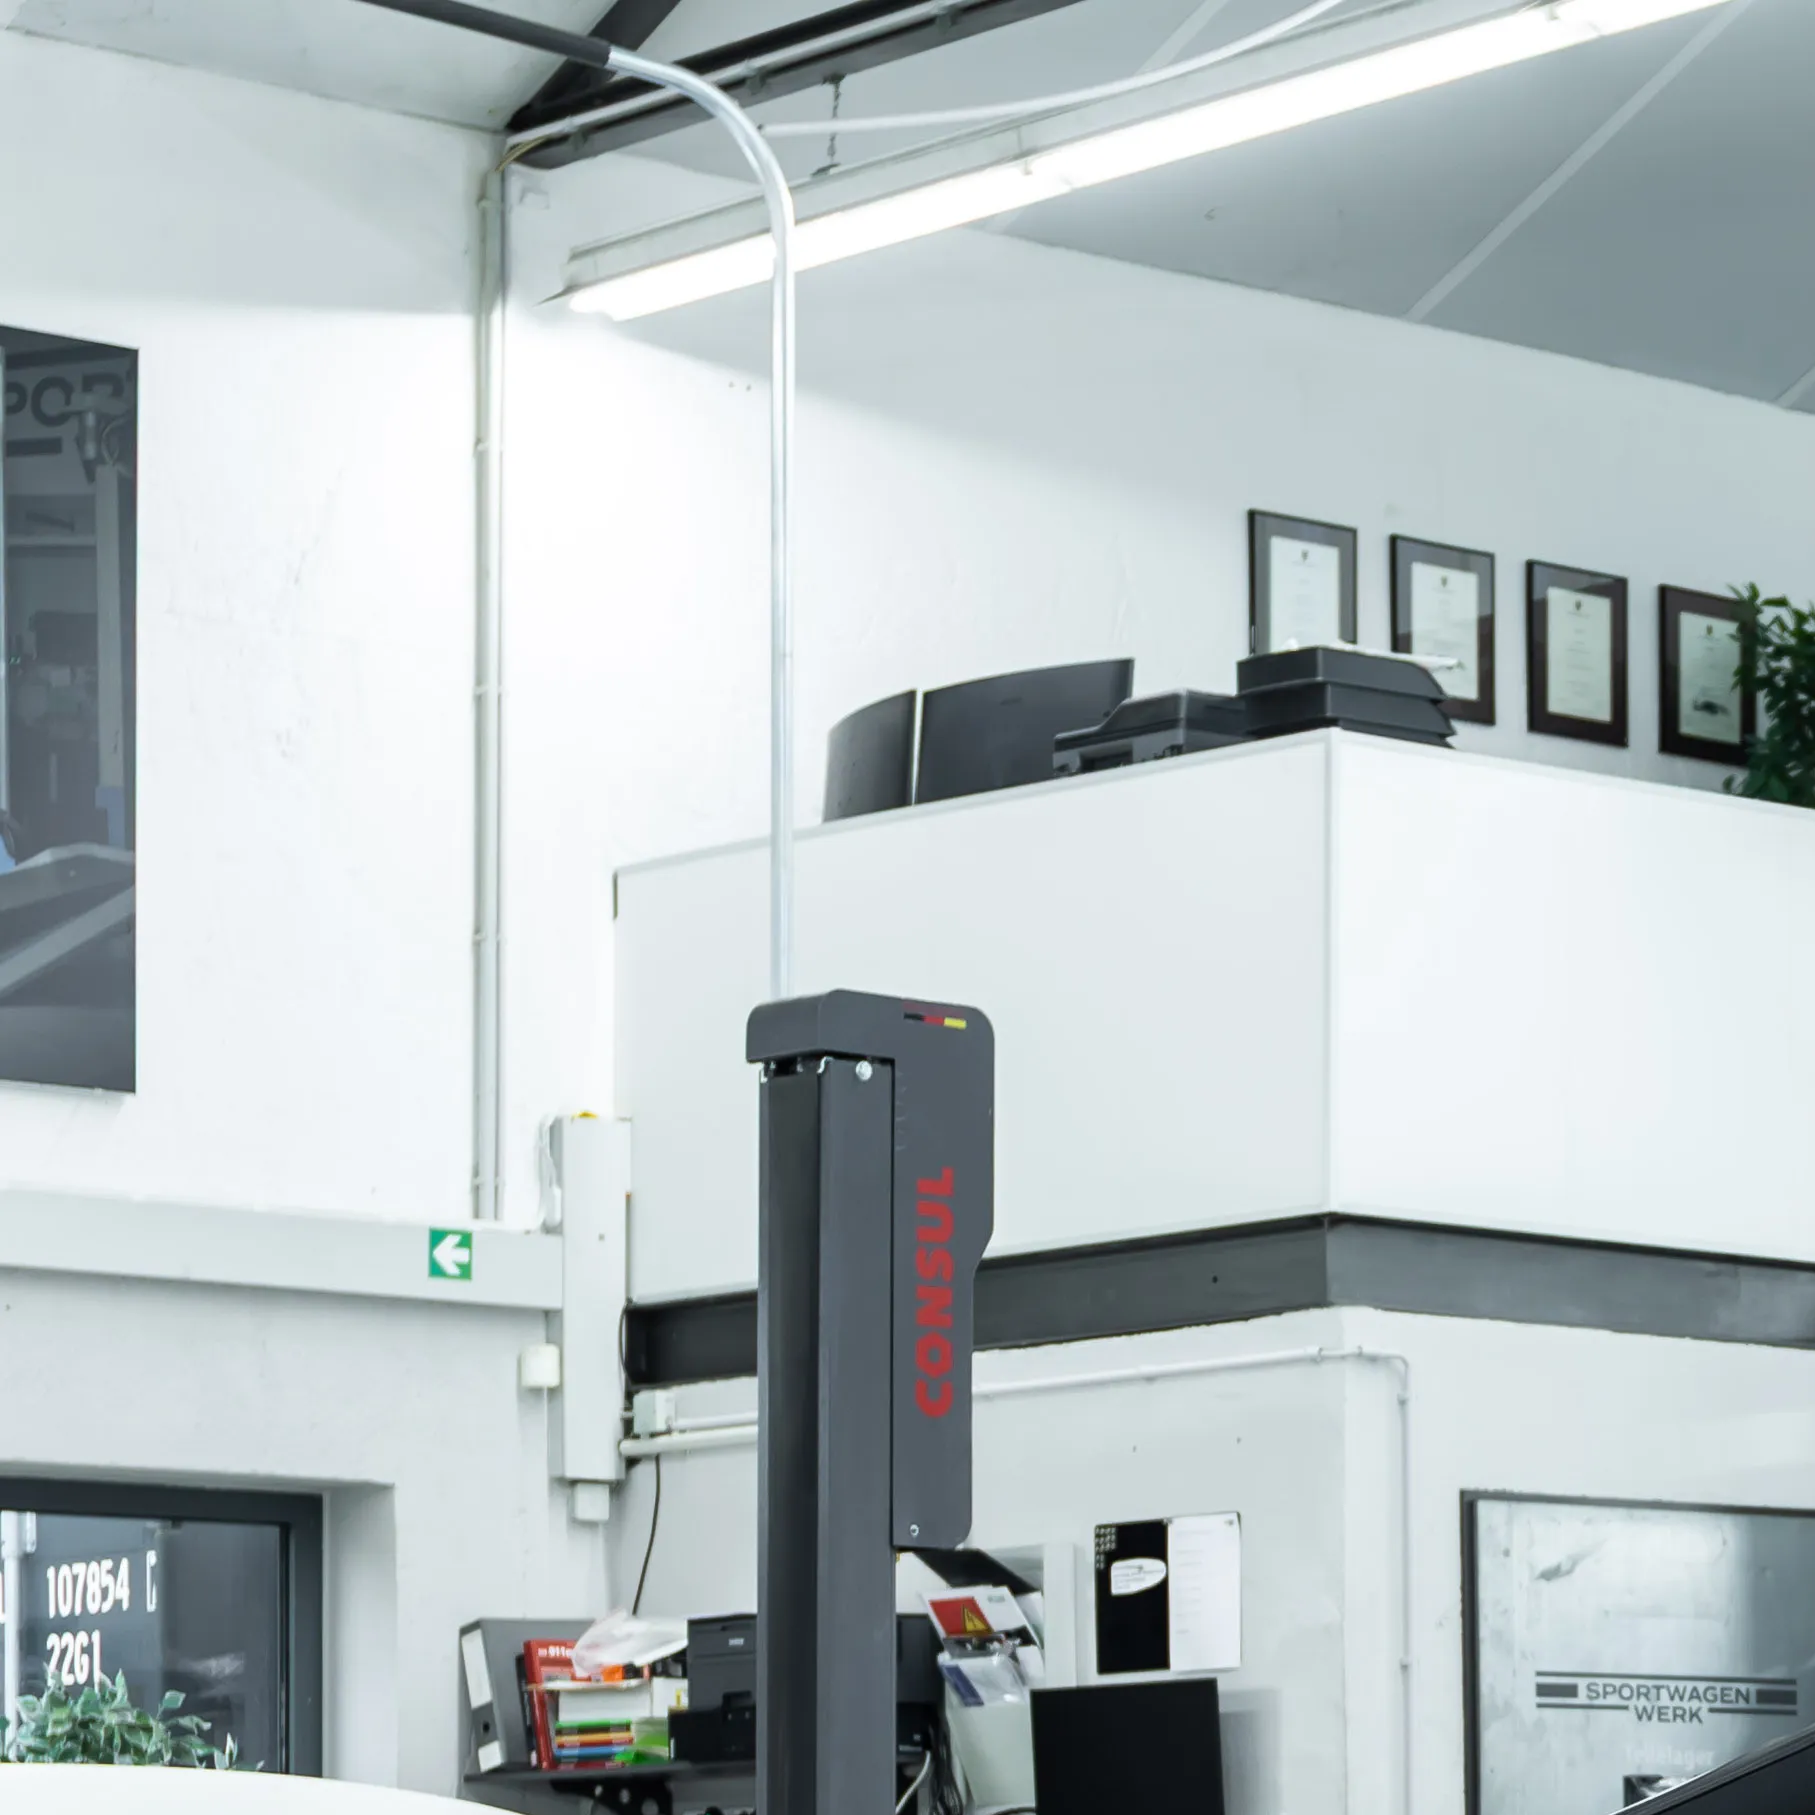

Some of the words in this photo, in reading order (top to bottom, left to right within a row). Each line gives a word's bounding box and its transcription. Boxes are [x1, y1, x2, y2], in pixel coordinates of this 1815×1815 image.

[915, 1166, 955, 1419] CONSUL
[46, 1557, 130, 1620] 107854
[46, 1629, 101, 1695] 22G1
[1585, 1681, 1750, 1706] SPORTWAGEN
[1633, 1705, 1704, 1725] WERK
